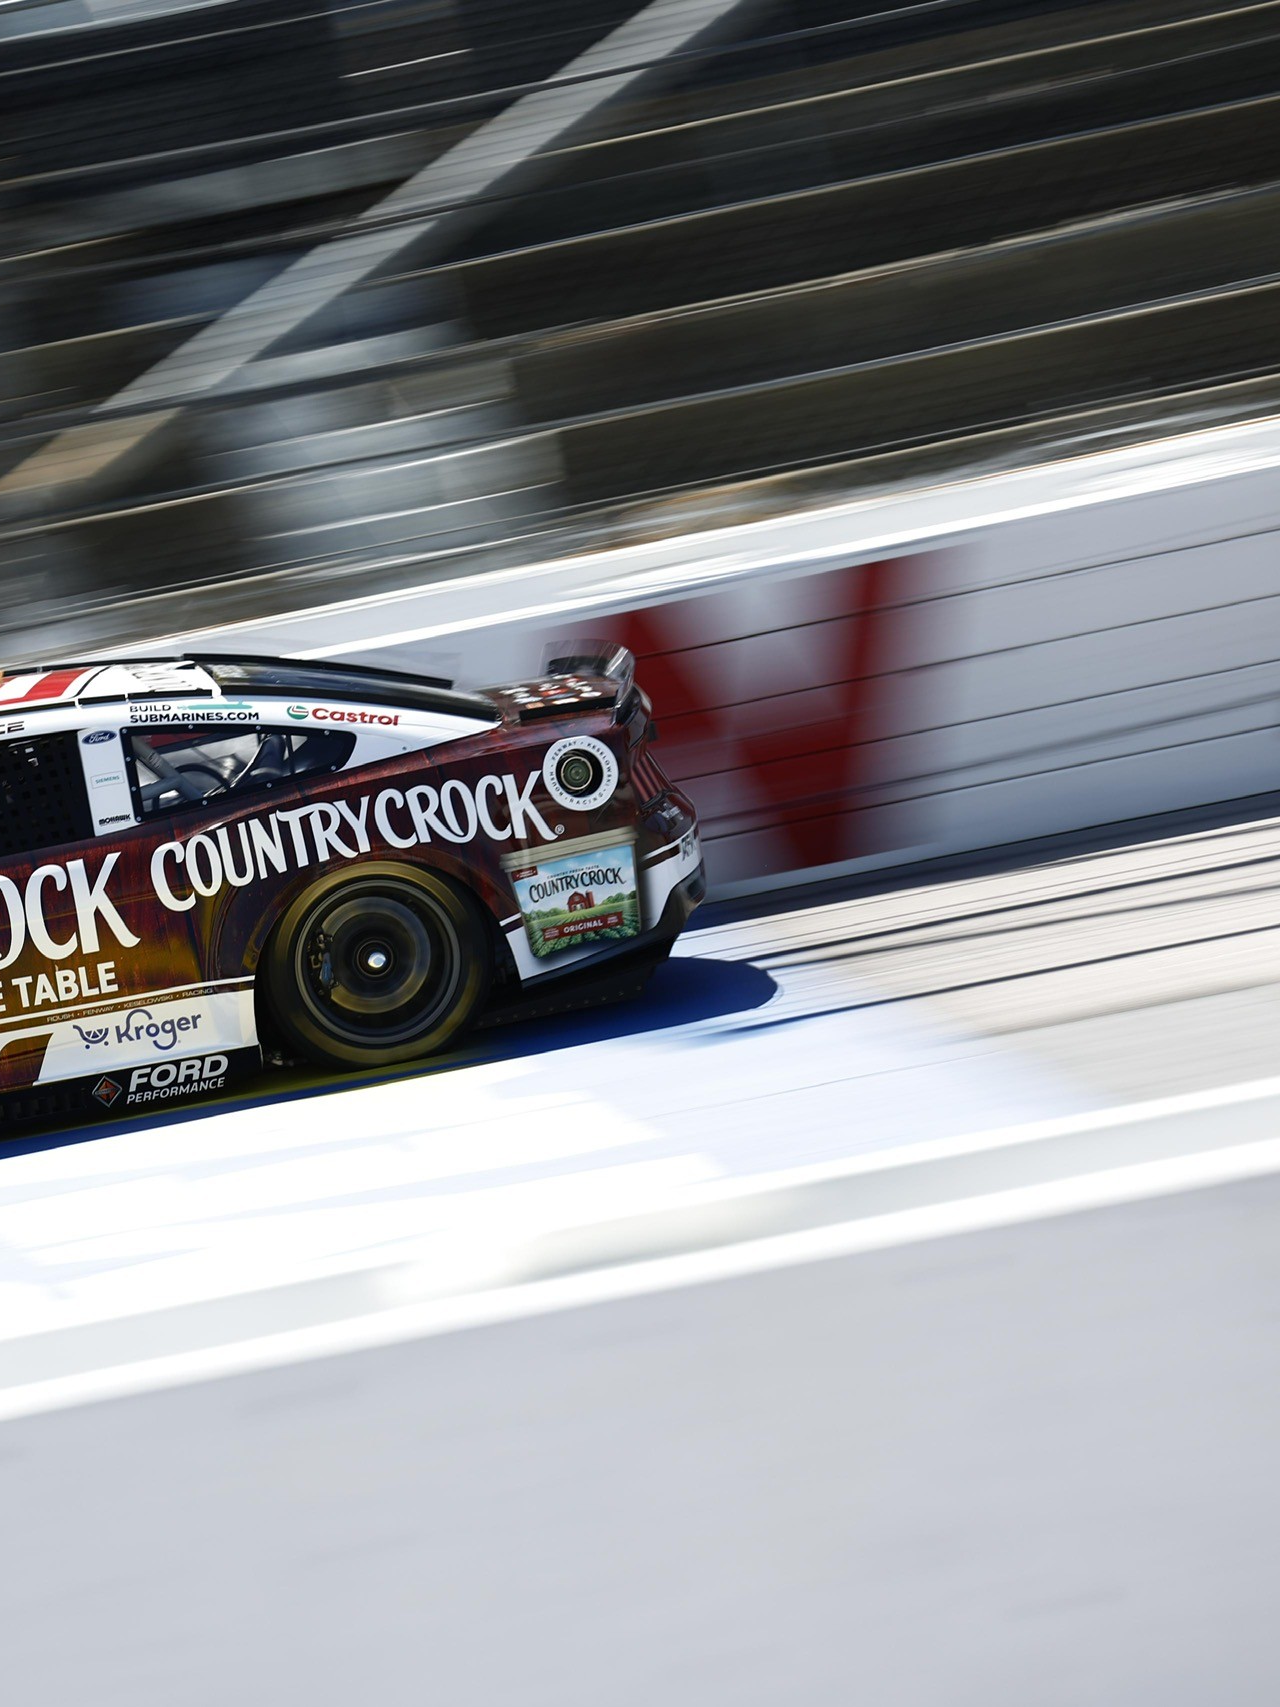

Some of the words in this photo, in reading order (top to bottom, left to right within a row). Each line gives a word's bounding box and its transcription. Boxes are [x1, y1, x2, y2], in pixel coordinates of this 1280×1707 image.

[129, 704, 172, 713] BUILD
[312, 707, 401, 726] Castrol
[129, 711, 260, 724] SUBMARINES.COM
[89, 732, 111, 744] Ford
[95, 775, 120, 784] SIEMENS
[99, 814, 131, 825] MOHAWK
[563, 919, 604, 933] ORIGINAL
[11, 961, 119, 1010] TABLE
[46, 1013, 75, 1023] ROUSH
[82, 1005, 115, 1016] FENWAY
[123, 995, 174, 1008] KESELOWSKI
[182, 988, 214, 997] RACING
[115, 1008, 202, 1050] Kroger
[129, 1054, 229, 1093] FORD
[126, 1077, 226, 1105] PERFORMANCE
